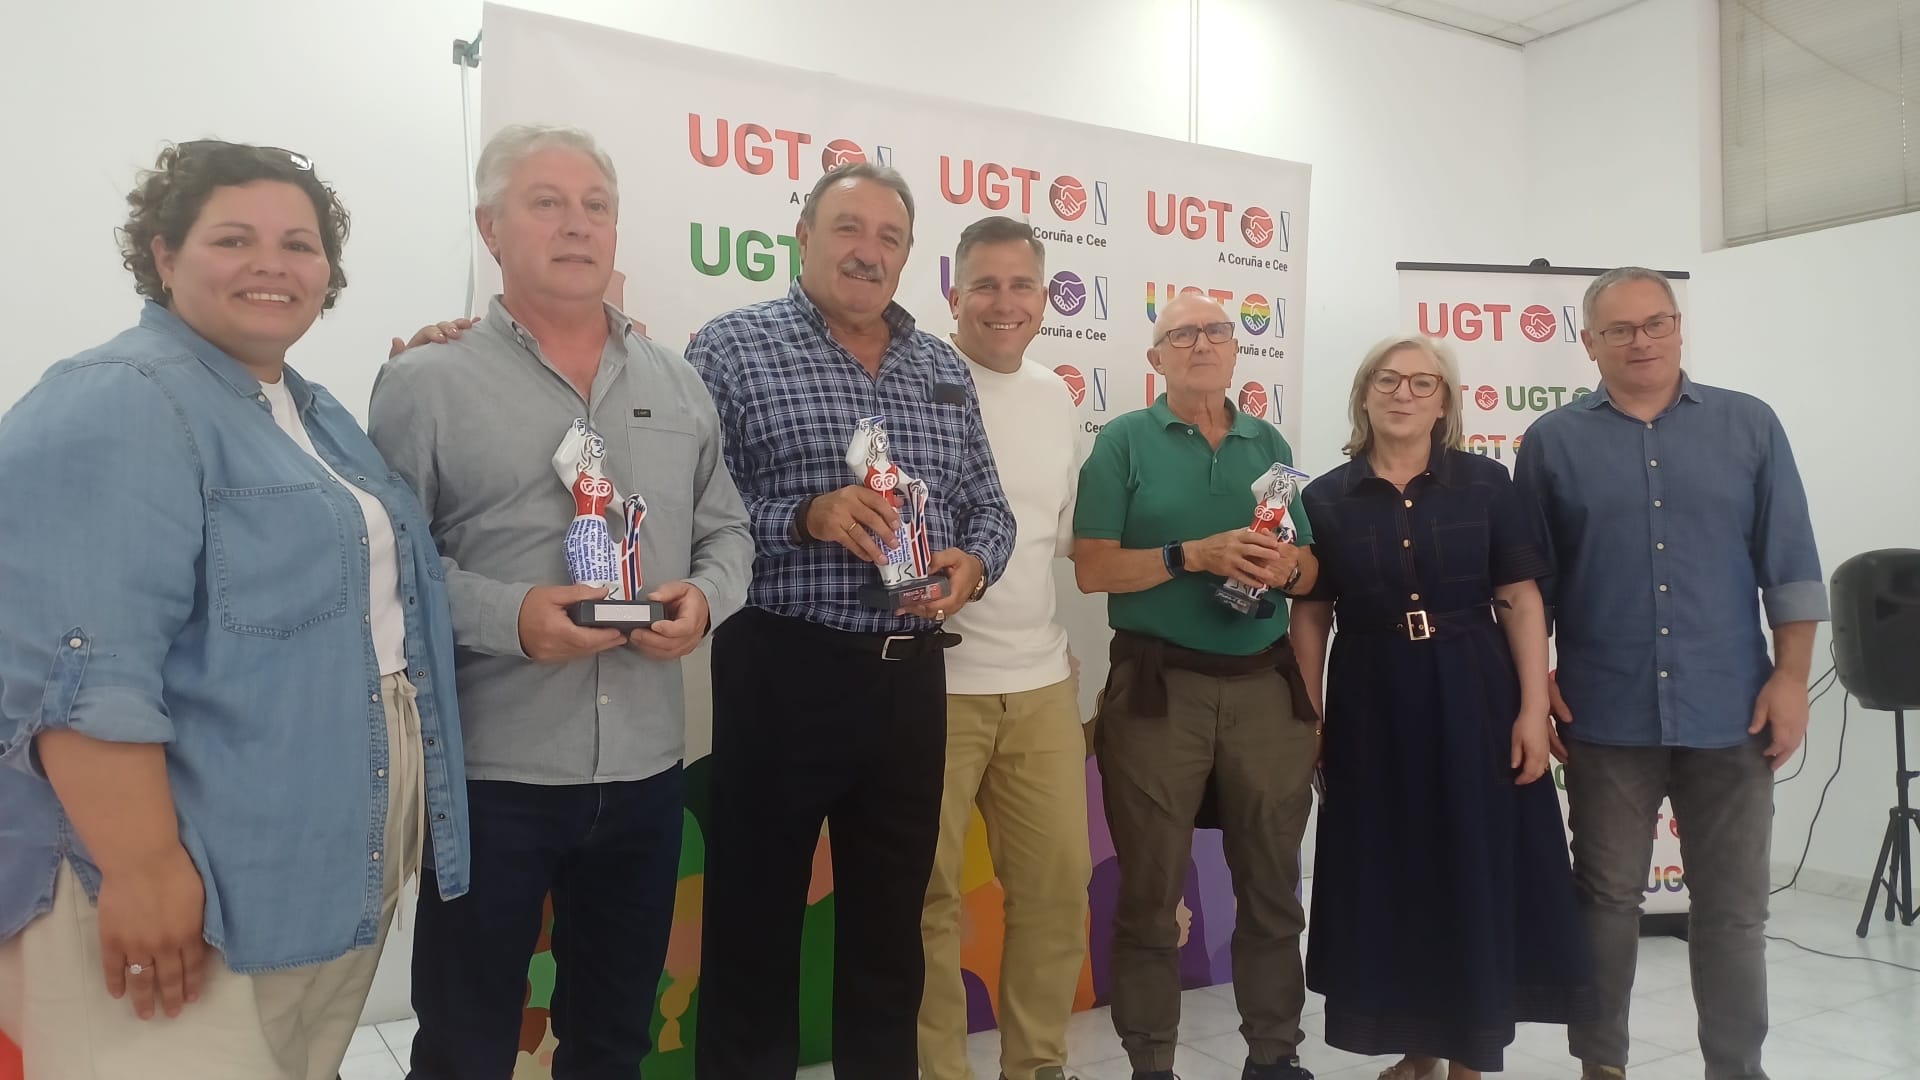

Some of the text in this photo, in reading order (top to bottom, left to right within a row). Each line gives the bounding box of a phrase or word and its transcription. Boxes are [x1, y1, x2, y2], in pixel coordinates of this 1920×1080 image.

[689, 112, 811, 181] UGT
[940, 155, 1040, 214] UGT
[1147, 190, 1232, 242] UGT
[1033, 226, 1106, 247] Coruña e Cee
[1218, 251, 1288, 272] A Coruña e Cee
[1040, 325, 1107, 341] oruña e Cee
[1418, 302, 1511, 341] UGT
[1261, 348, 1267, 357] e
[1268, 346, 1284, 359] Cee
[1505, 385, 1567, 411] UGT
